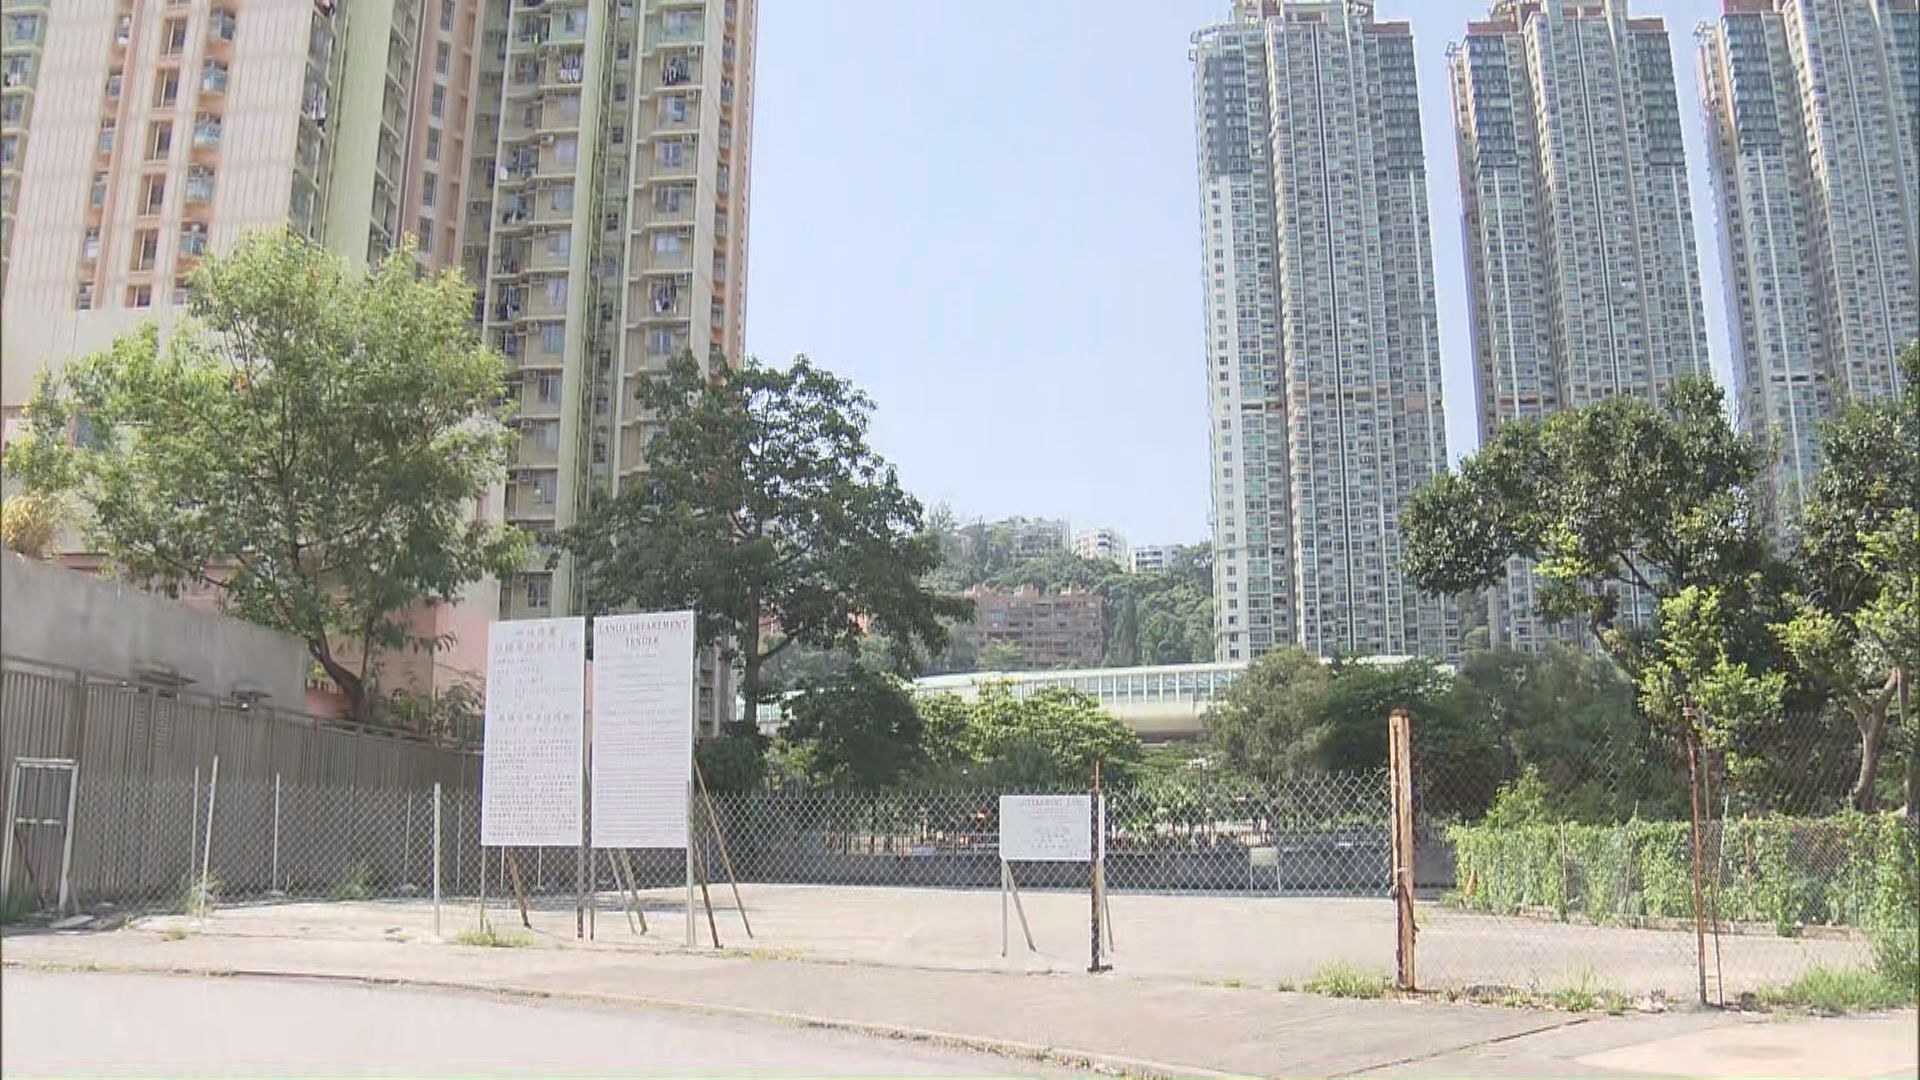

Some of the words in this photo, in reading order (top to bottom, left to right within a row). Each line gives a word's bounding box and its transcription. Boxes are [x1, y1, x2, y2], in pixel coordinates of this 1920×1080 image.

[599, 623, 625, 635] LANDS
[630, 619, 687, 632] DEPARTMENT
[625, 637, 659, 647] TENDER
